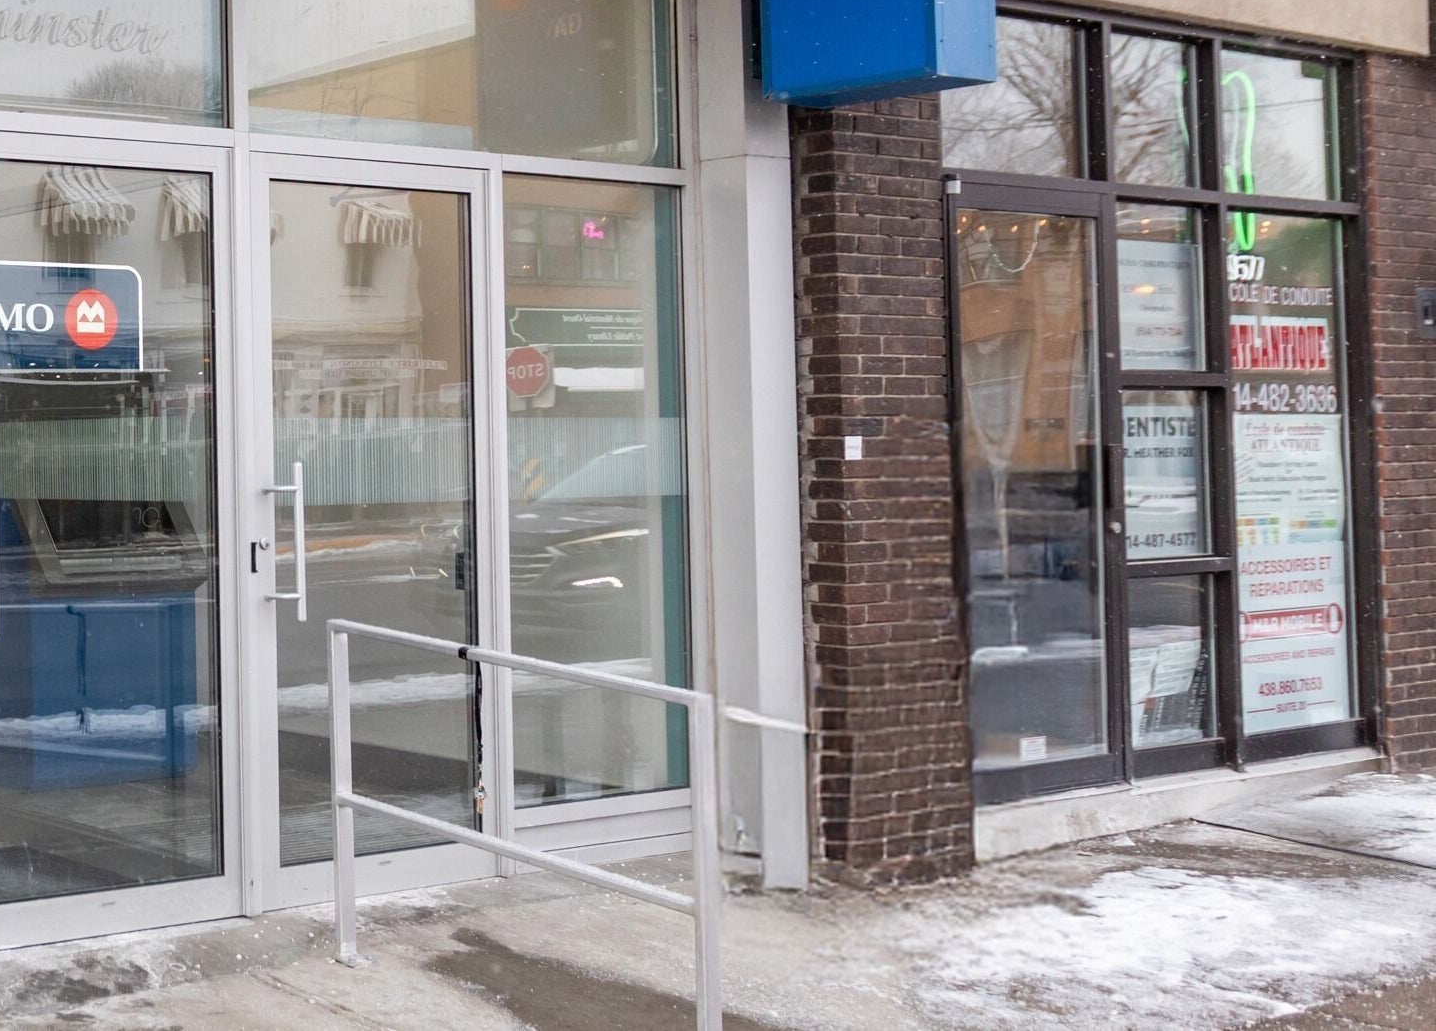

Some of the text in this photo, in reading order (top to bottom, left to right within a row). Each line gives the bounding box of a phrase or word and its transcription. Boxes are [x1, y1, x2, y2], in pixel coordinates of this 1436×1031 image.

[1264, 285, 1279, 304] DE
[1280, 287, 1334, 306] CONDUITE
[1124, 416, 1196, 438] ENTISTE
[1134, 448, 1176, 458] HEATHER
[1240, 556, 1332, 575] ACCESSOIRES ET
